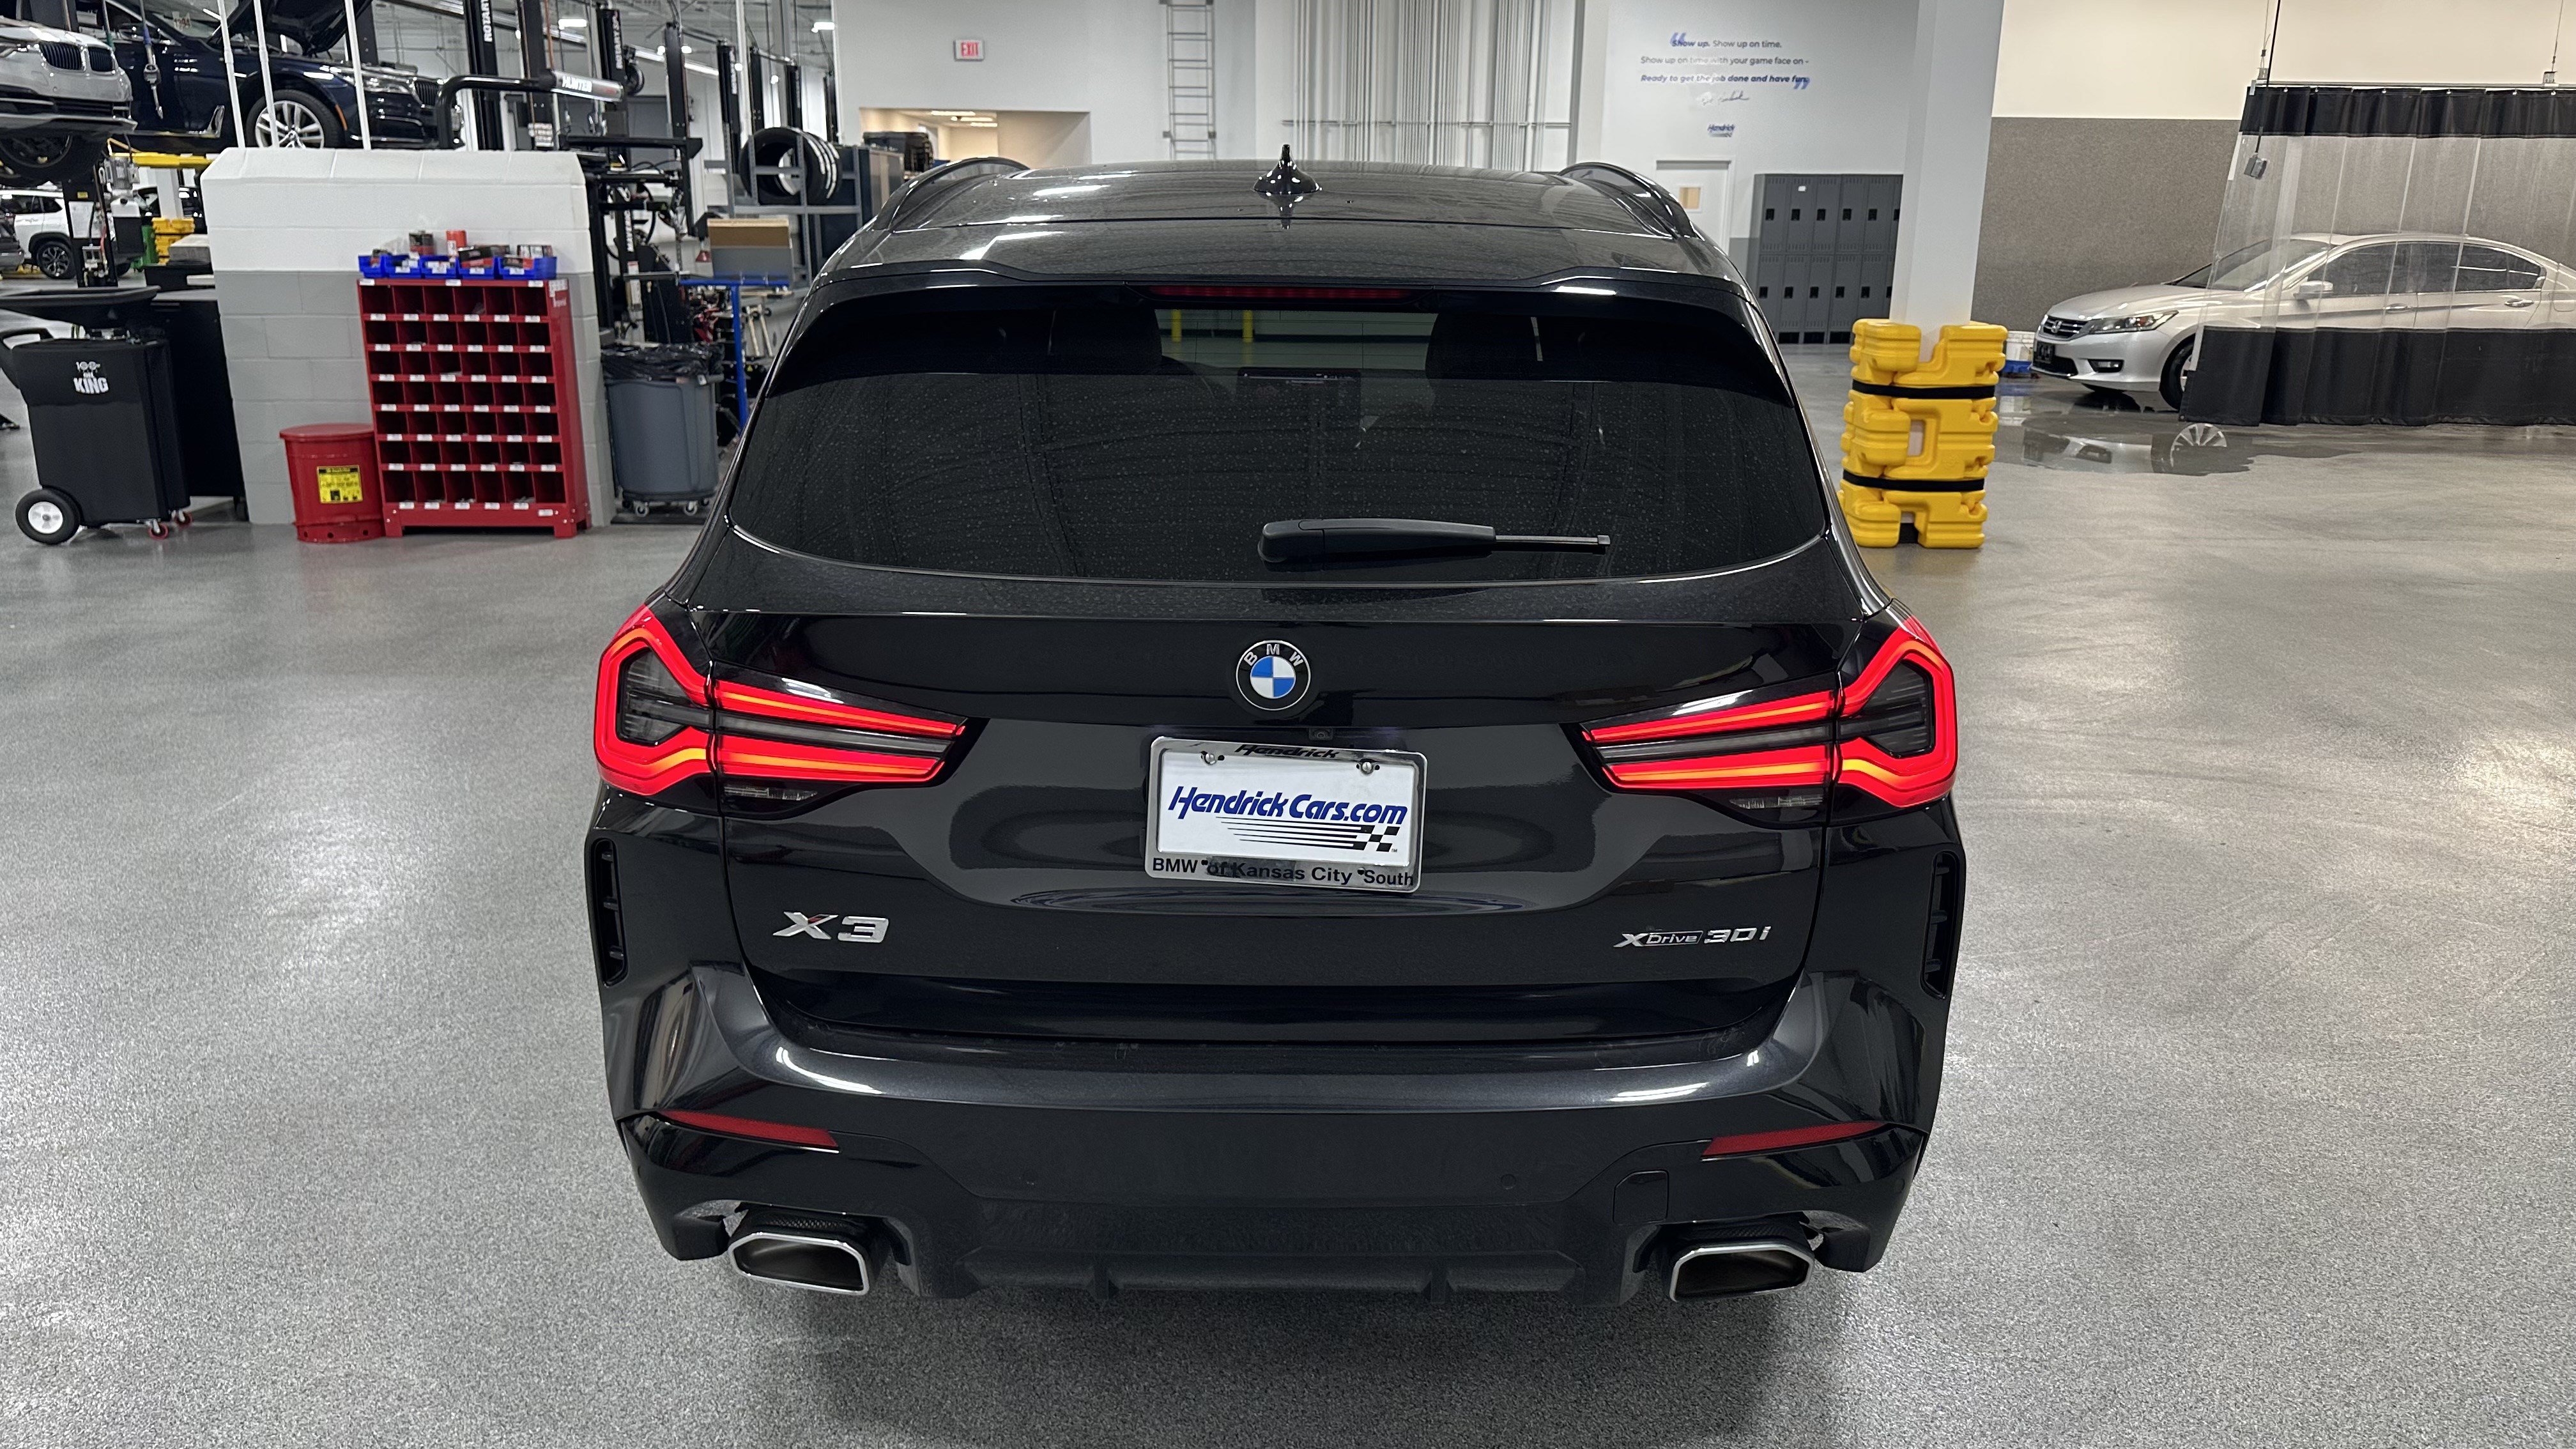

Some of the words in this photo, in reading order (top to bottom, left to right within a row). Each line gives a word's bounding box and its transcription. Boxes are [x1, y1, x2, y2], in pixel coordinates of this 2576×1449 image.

[961, 42, 979, 56] EXIT
[1641, 56, 1663, 64] Show
[1775, 56, 1791, 65] face
[562, 76, 592, 93] HUNTER
[1641, 75, 1667, 83] Ready
[73, 377, 109, 394] KING
[1244, 643, 1304, 667] BMW
[1234, 744, 1339, 758] Hendrick
[1153, 857, 1198, 873] BMW
[1207, 861, 1229, 875] of
[1231, 862, 1305, 880] Kansas
[1312, 866, 1353, 885] City
[1363, 870, 1414, 886] South
[772, 911, 889, 943] X3
